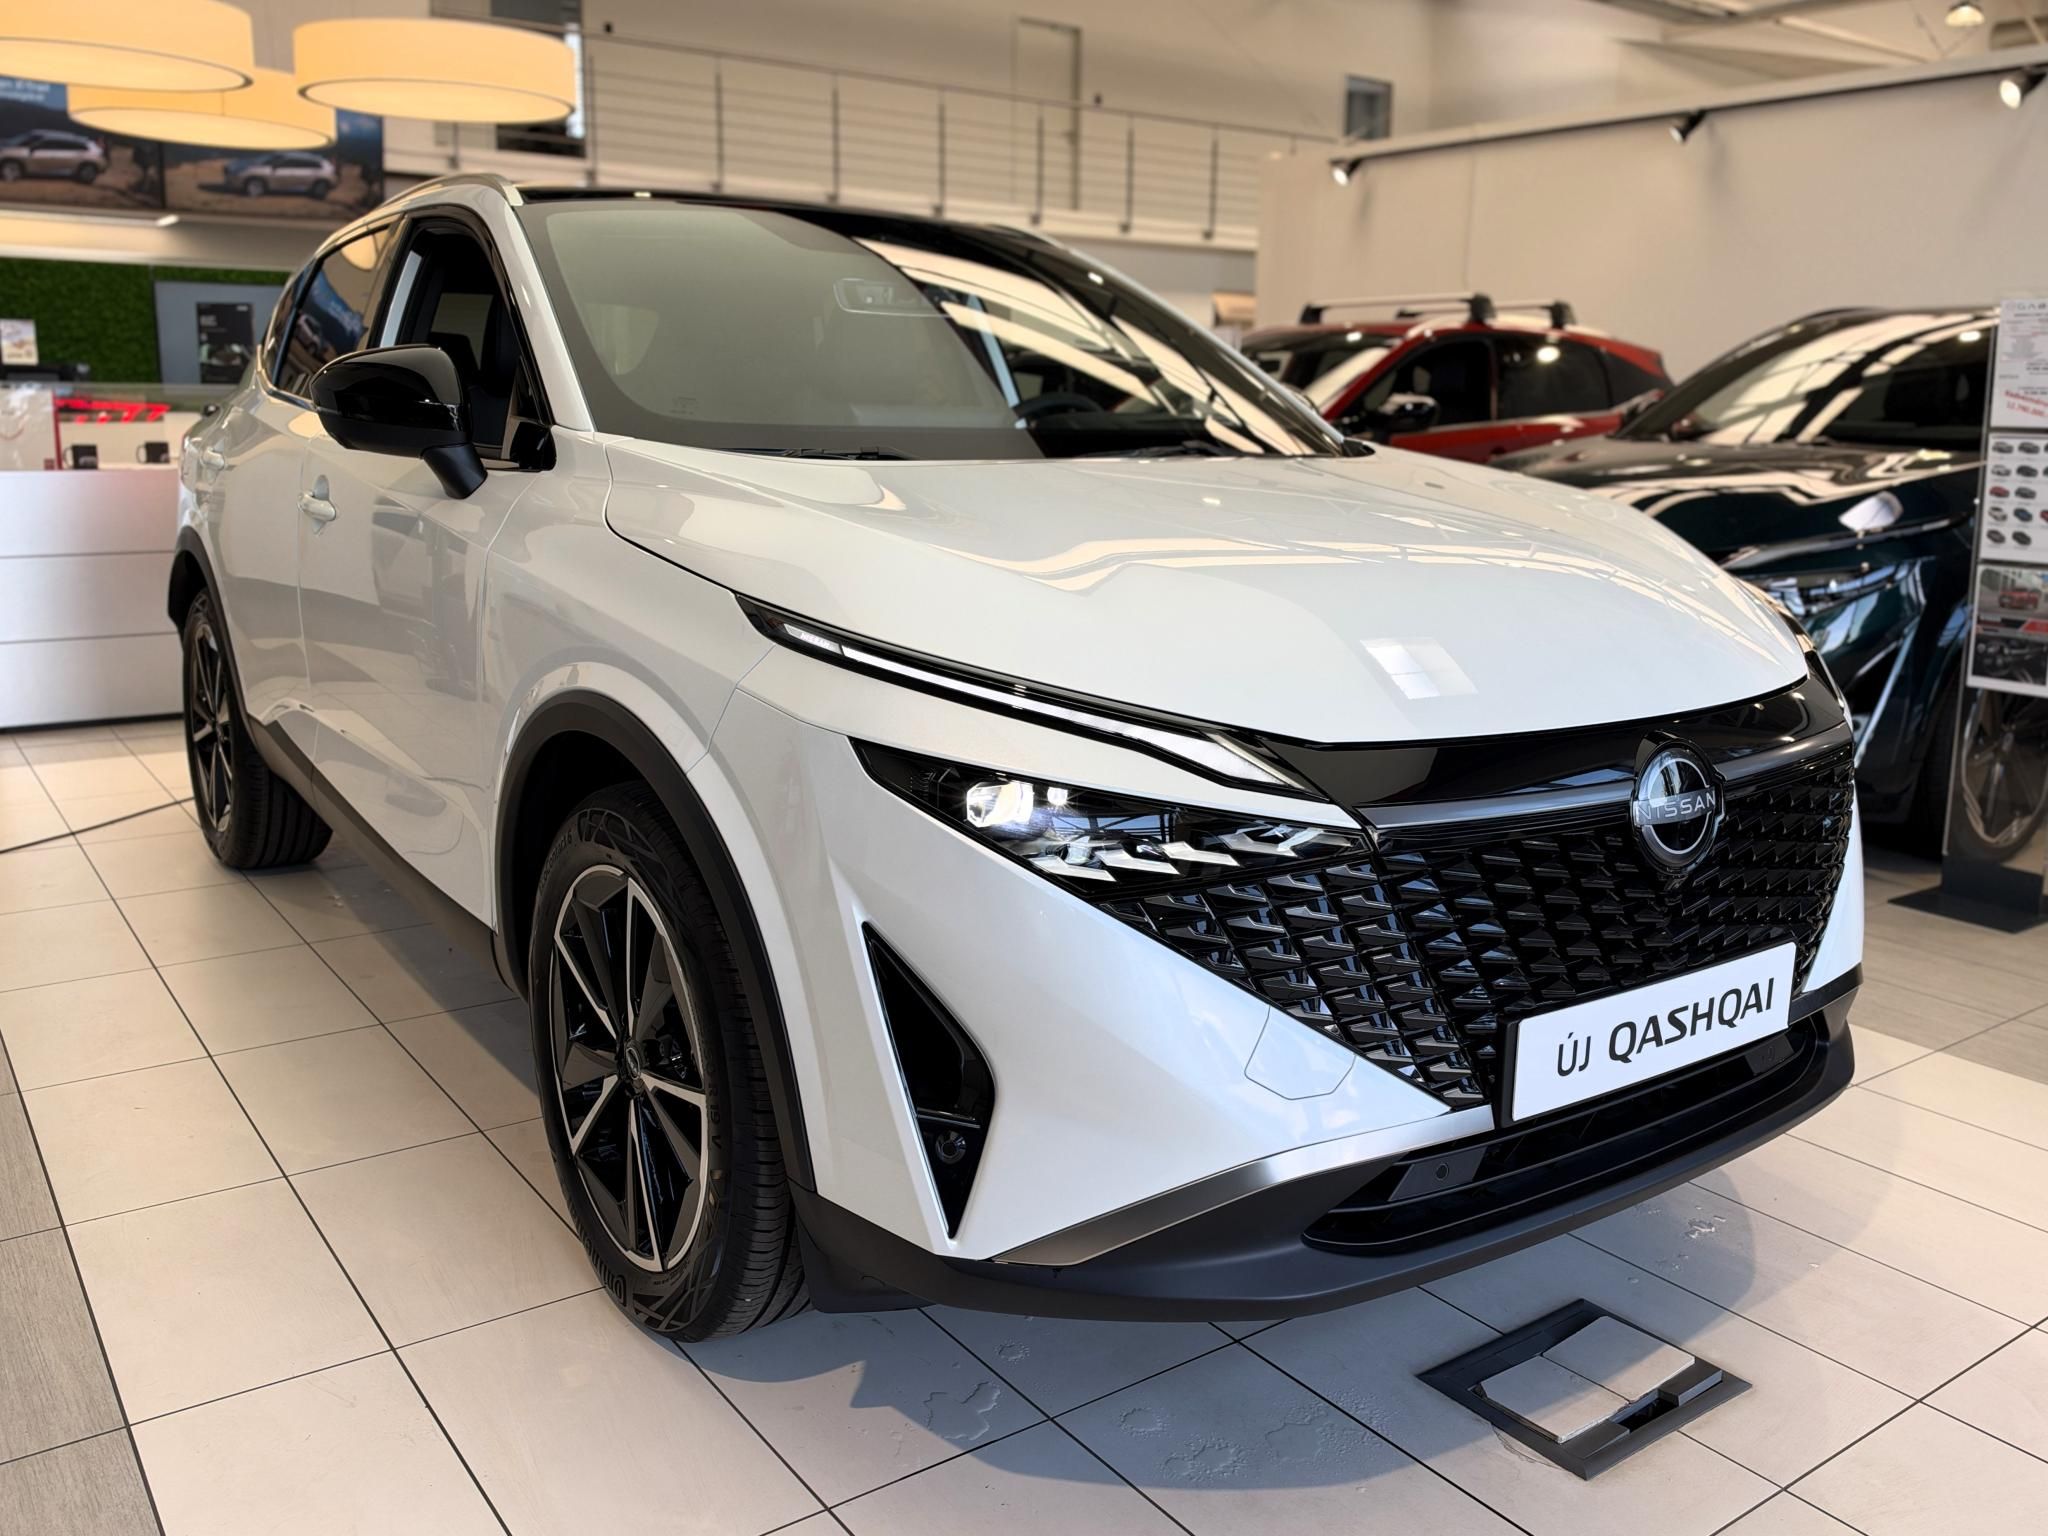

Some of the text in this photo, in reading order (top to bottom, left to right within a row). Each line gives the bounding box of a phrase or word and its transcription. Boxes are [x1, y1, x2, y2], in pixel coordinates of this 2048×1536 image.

[1635, 787, 1715, 821] NISSAN
[1557, 978, 1774, 1077] ÚJ QASHQAI
